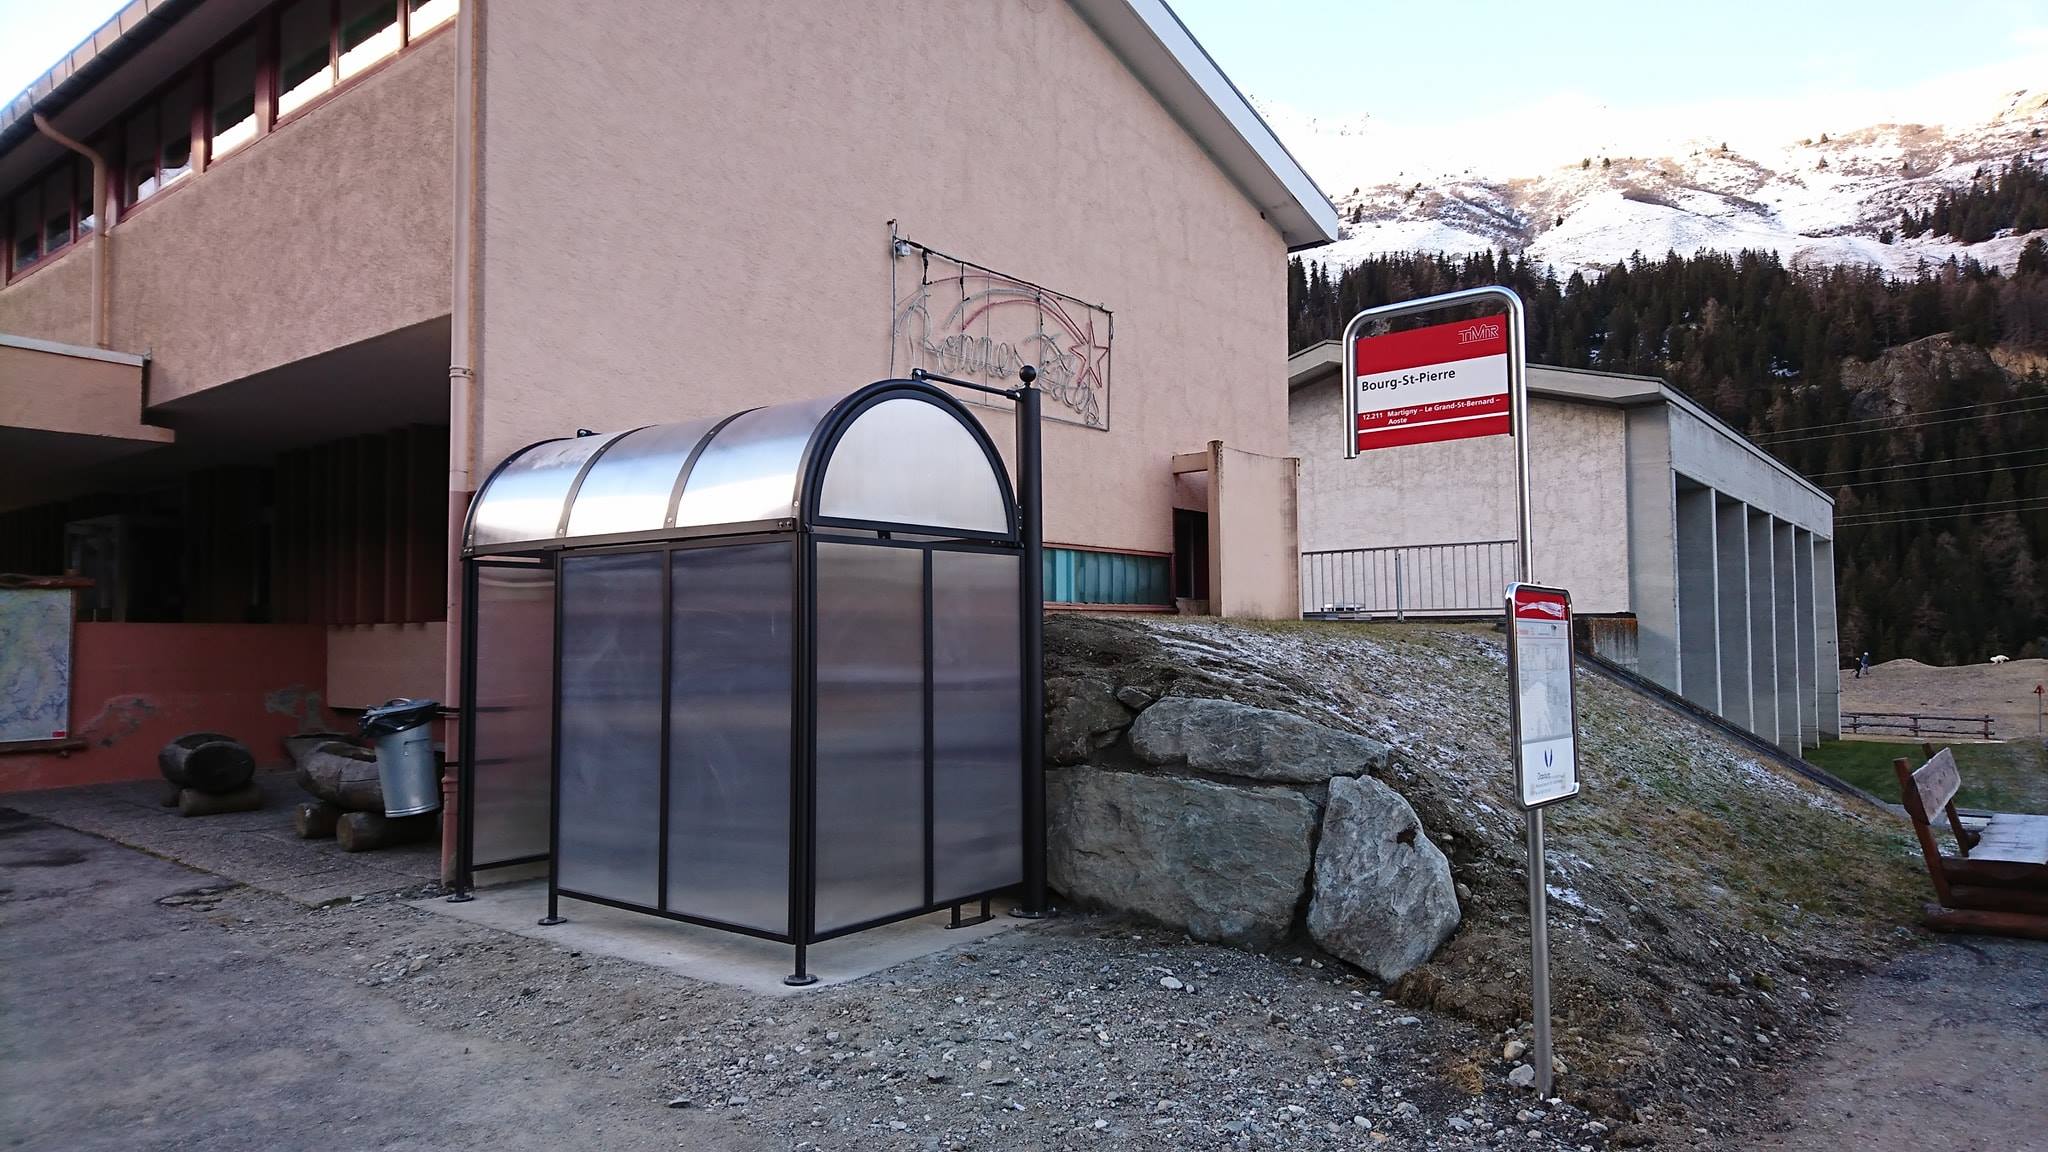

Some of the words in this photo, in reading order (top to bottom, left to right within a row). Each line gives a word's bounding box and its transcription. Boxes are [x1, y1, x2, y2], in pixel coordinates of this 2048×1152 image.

[1458, 324, 1499, 344] TMR
[1361, 369, 1456, 391] Bourg-St-Pierre
[1362, 412, 1383, 420] 12.211
[1387, 408, 1418, 417] Martigny
[1424, 405, 1433, 413] Le
[1434, 397, 1495, 411] Grand-St-Bernard
[1387, 417, 1408, 425] Aoste
